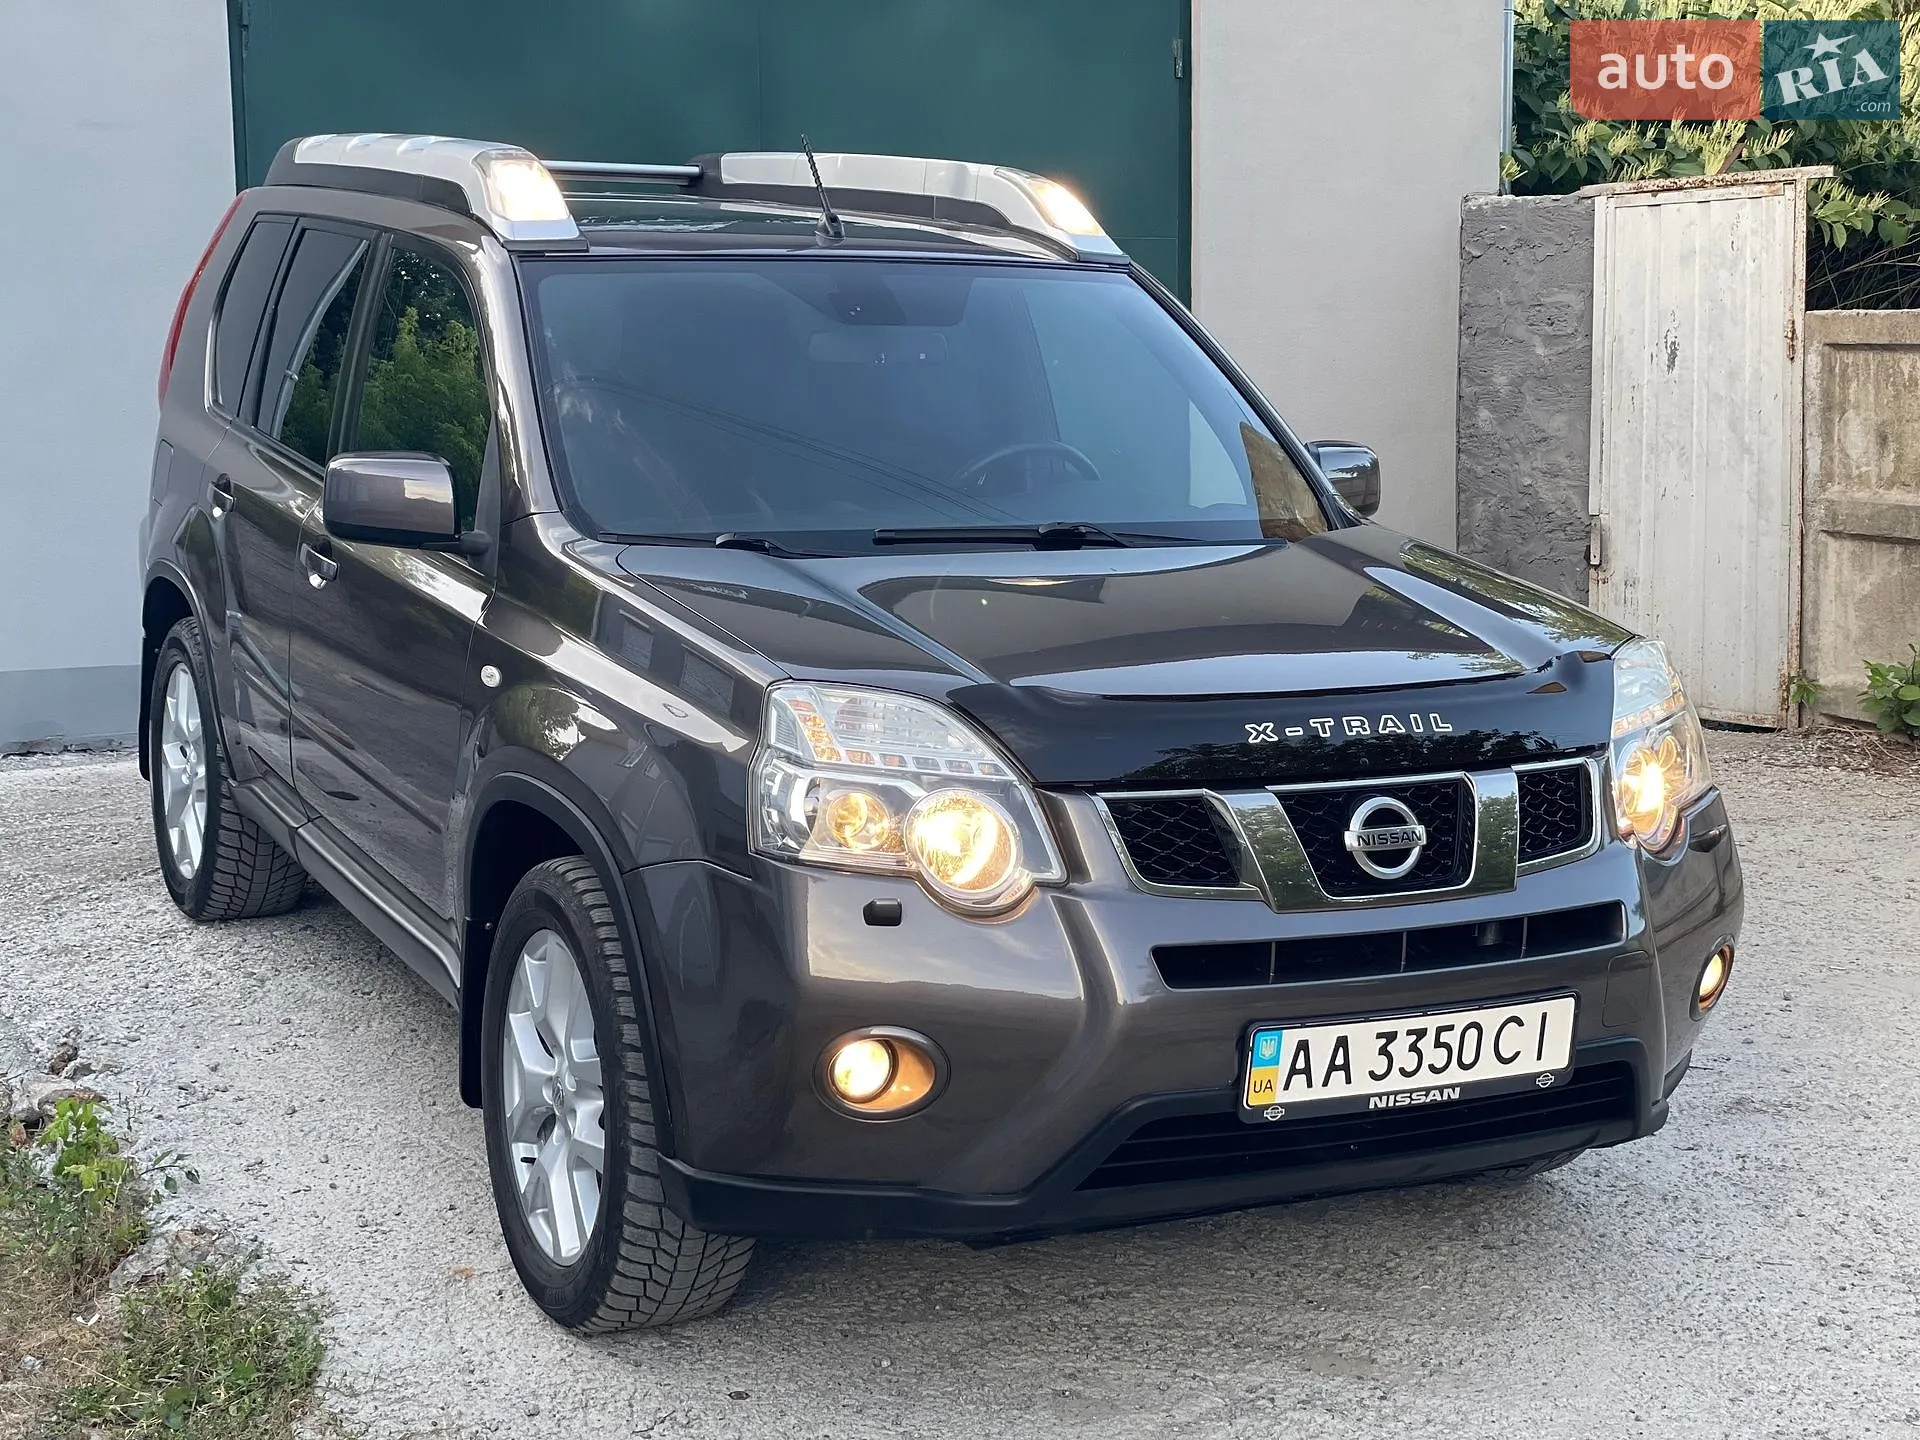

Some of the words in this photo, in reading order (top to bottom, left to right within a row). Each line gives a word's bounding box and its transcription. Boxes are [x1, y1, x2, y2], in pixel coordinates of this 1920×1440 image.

[1245, 713, 1452, 743] X-TRAIL
[1356, 830, 1422, 847] NISSAN
[1283, 1035, 1351, 1091] AA
[1368, 1021, 1484, 1081] 3350
[1252, 1079, 1274, 1094] UA
[1368, 1087, 1460, 1109] NISSAN
